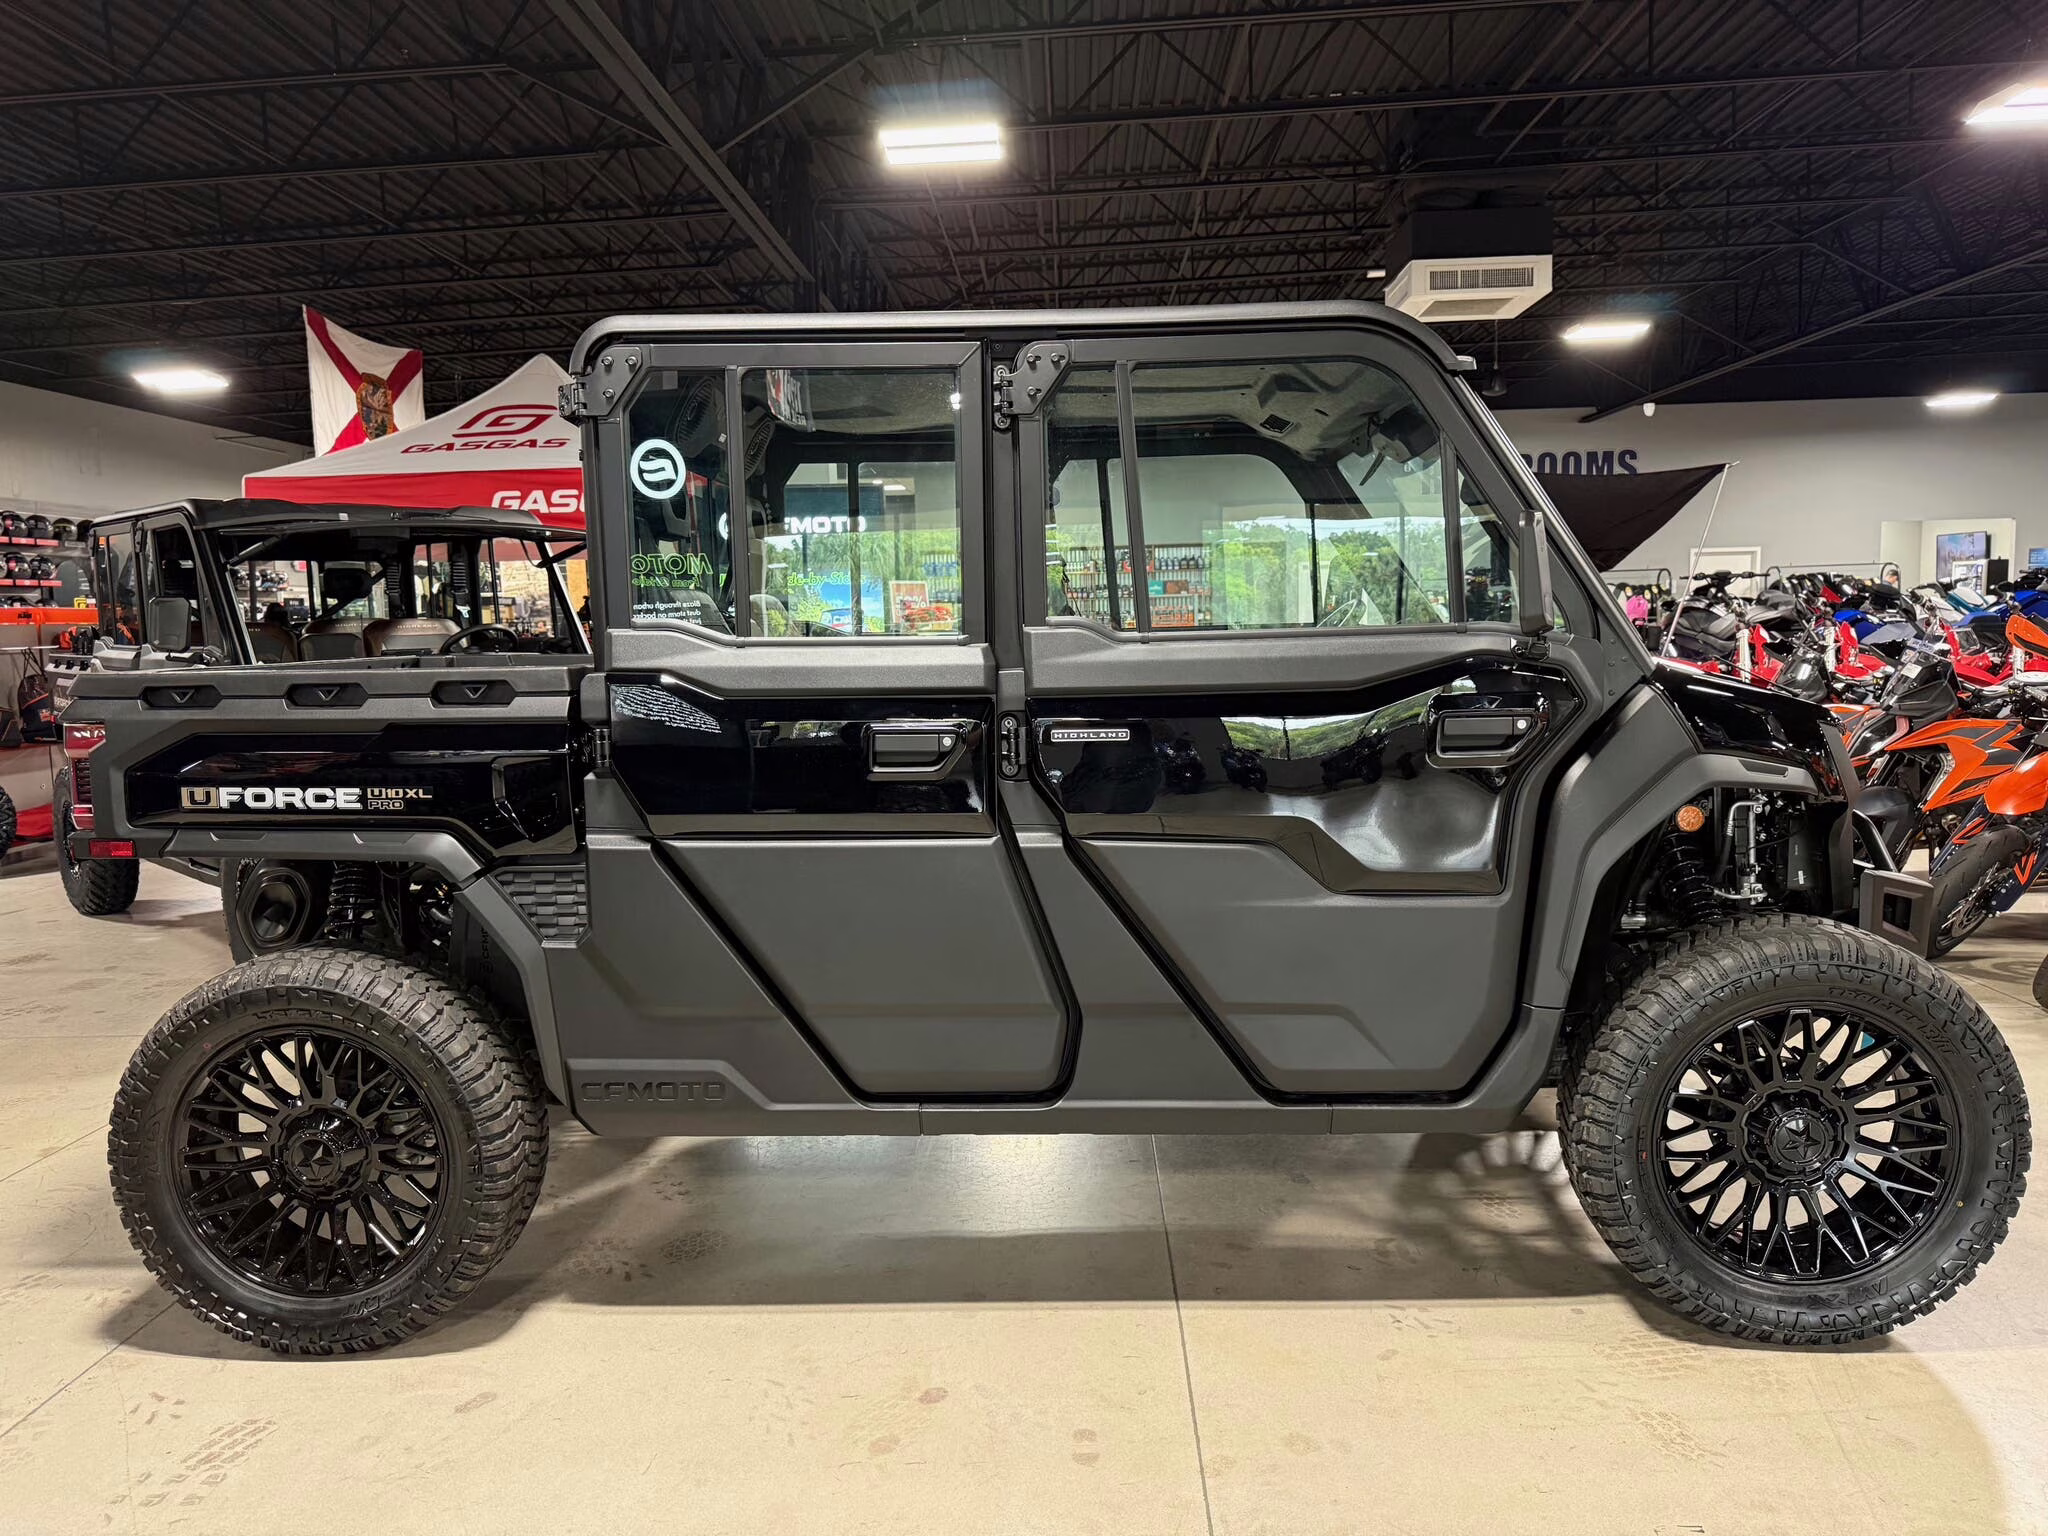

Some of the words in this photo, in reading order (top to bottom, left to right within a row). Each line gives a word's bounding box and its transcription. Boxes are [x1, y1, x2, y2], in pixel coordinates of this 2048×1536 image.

[401, 438, 571, 454] GASGAS
[491, 489, 585, 514] GAS
[1053, 731, 1128, 740] HIGHLAND
[367, 799, 404, 810] PRO
[581, 1081, 726, 1102] CFMOTO
